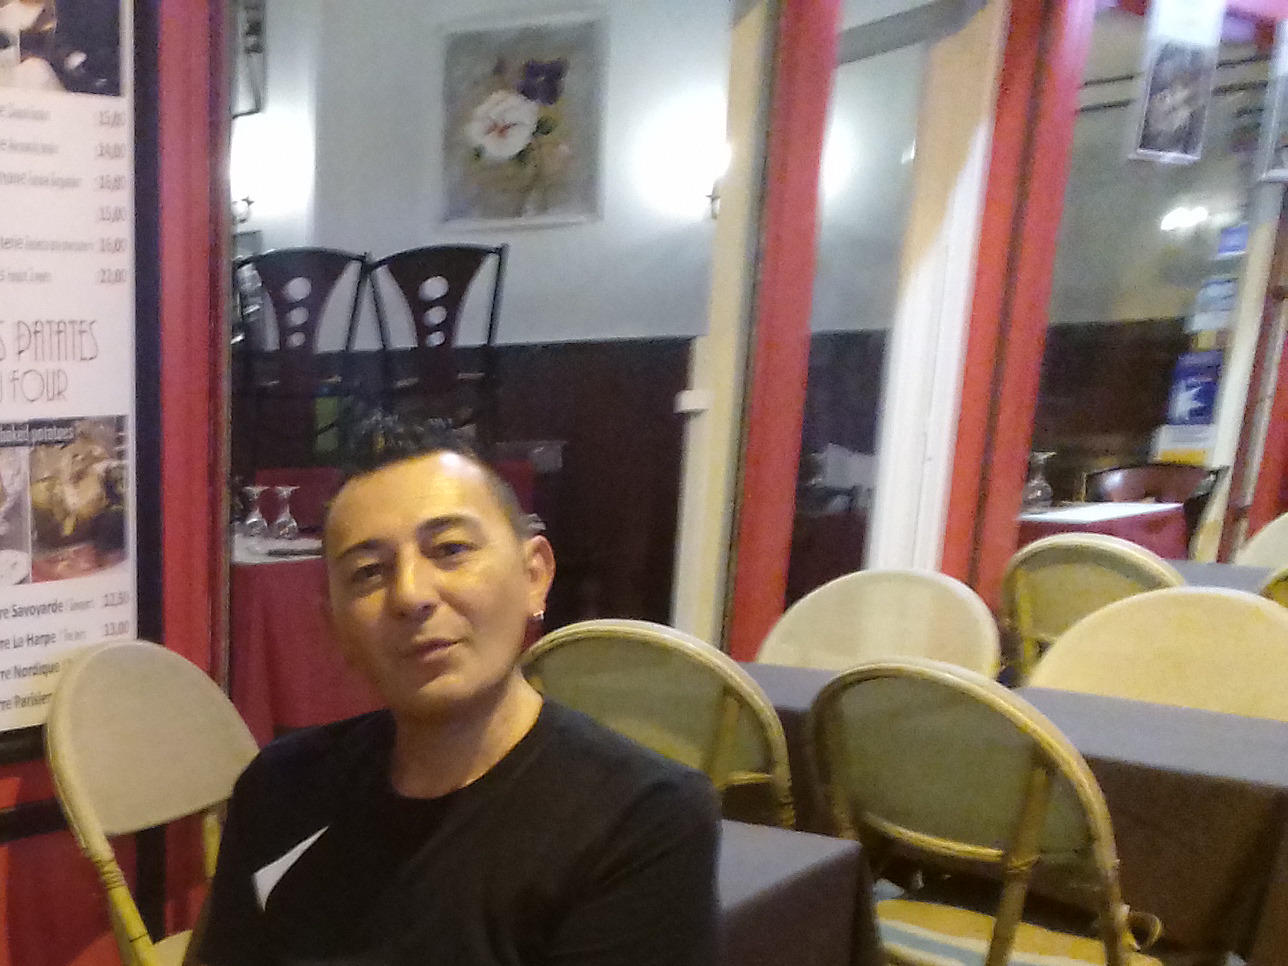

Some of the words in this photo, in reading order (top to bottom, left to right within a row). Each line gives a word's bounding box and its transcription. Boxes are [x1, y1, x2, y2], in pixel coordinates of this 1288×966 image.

[16, 319, 99, 363] PATATES
[10, 368, 68, 402] FOUR
[12, 599, 64, 619] Savoyarde
[12, 634, 25, 648] La
[26, 631, 57, 648] Harpe
[13, 660, 61, 677] Nordique
